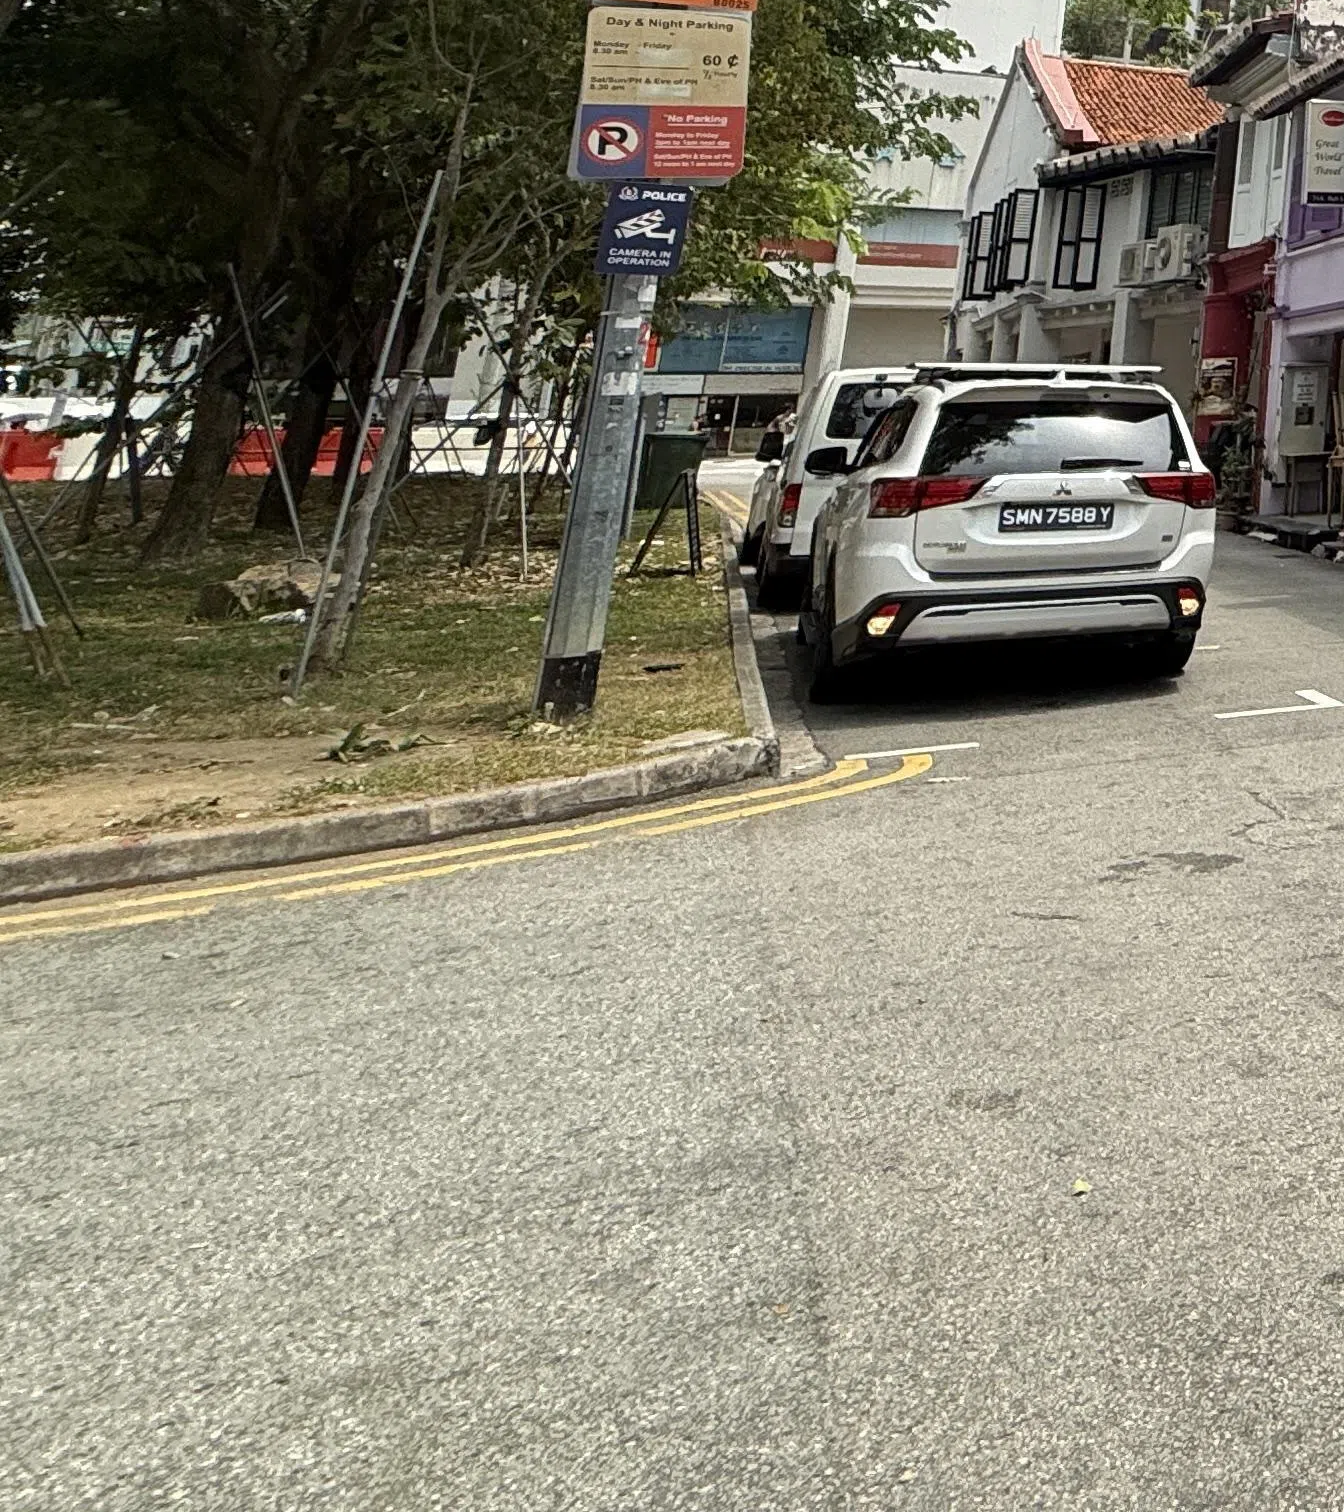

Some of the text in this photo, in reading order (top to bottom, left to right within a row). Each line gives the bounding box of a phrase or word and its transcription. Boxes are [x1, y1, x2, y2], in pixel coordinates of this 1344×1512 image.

[606, 16, 734, 33] Day & Night Parking
[593, 40, 673, 51] Monday Friday
[702, 54, 722, 67] 60
[667, 114, 728, 126] No Parking
[1315, 139, 1340, 149] Great
[641, 190, 687, 202] POLICE
[608, 248, 672, 259] CAMERA IN
[607, 256, 670, 268] OPERATION
[1002, 506, 1111, 526] SMN 7588 Y
